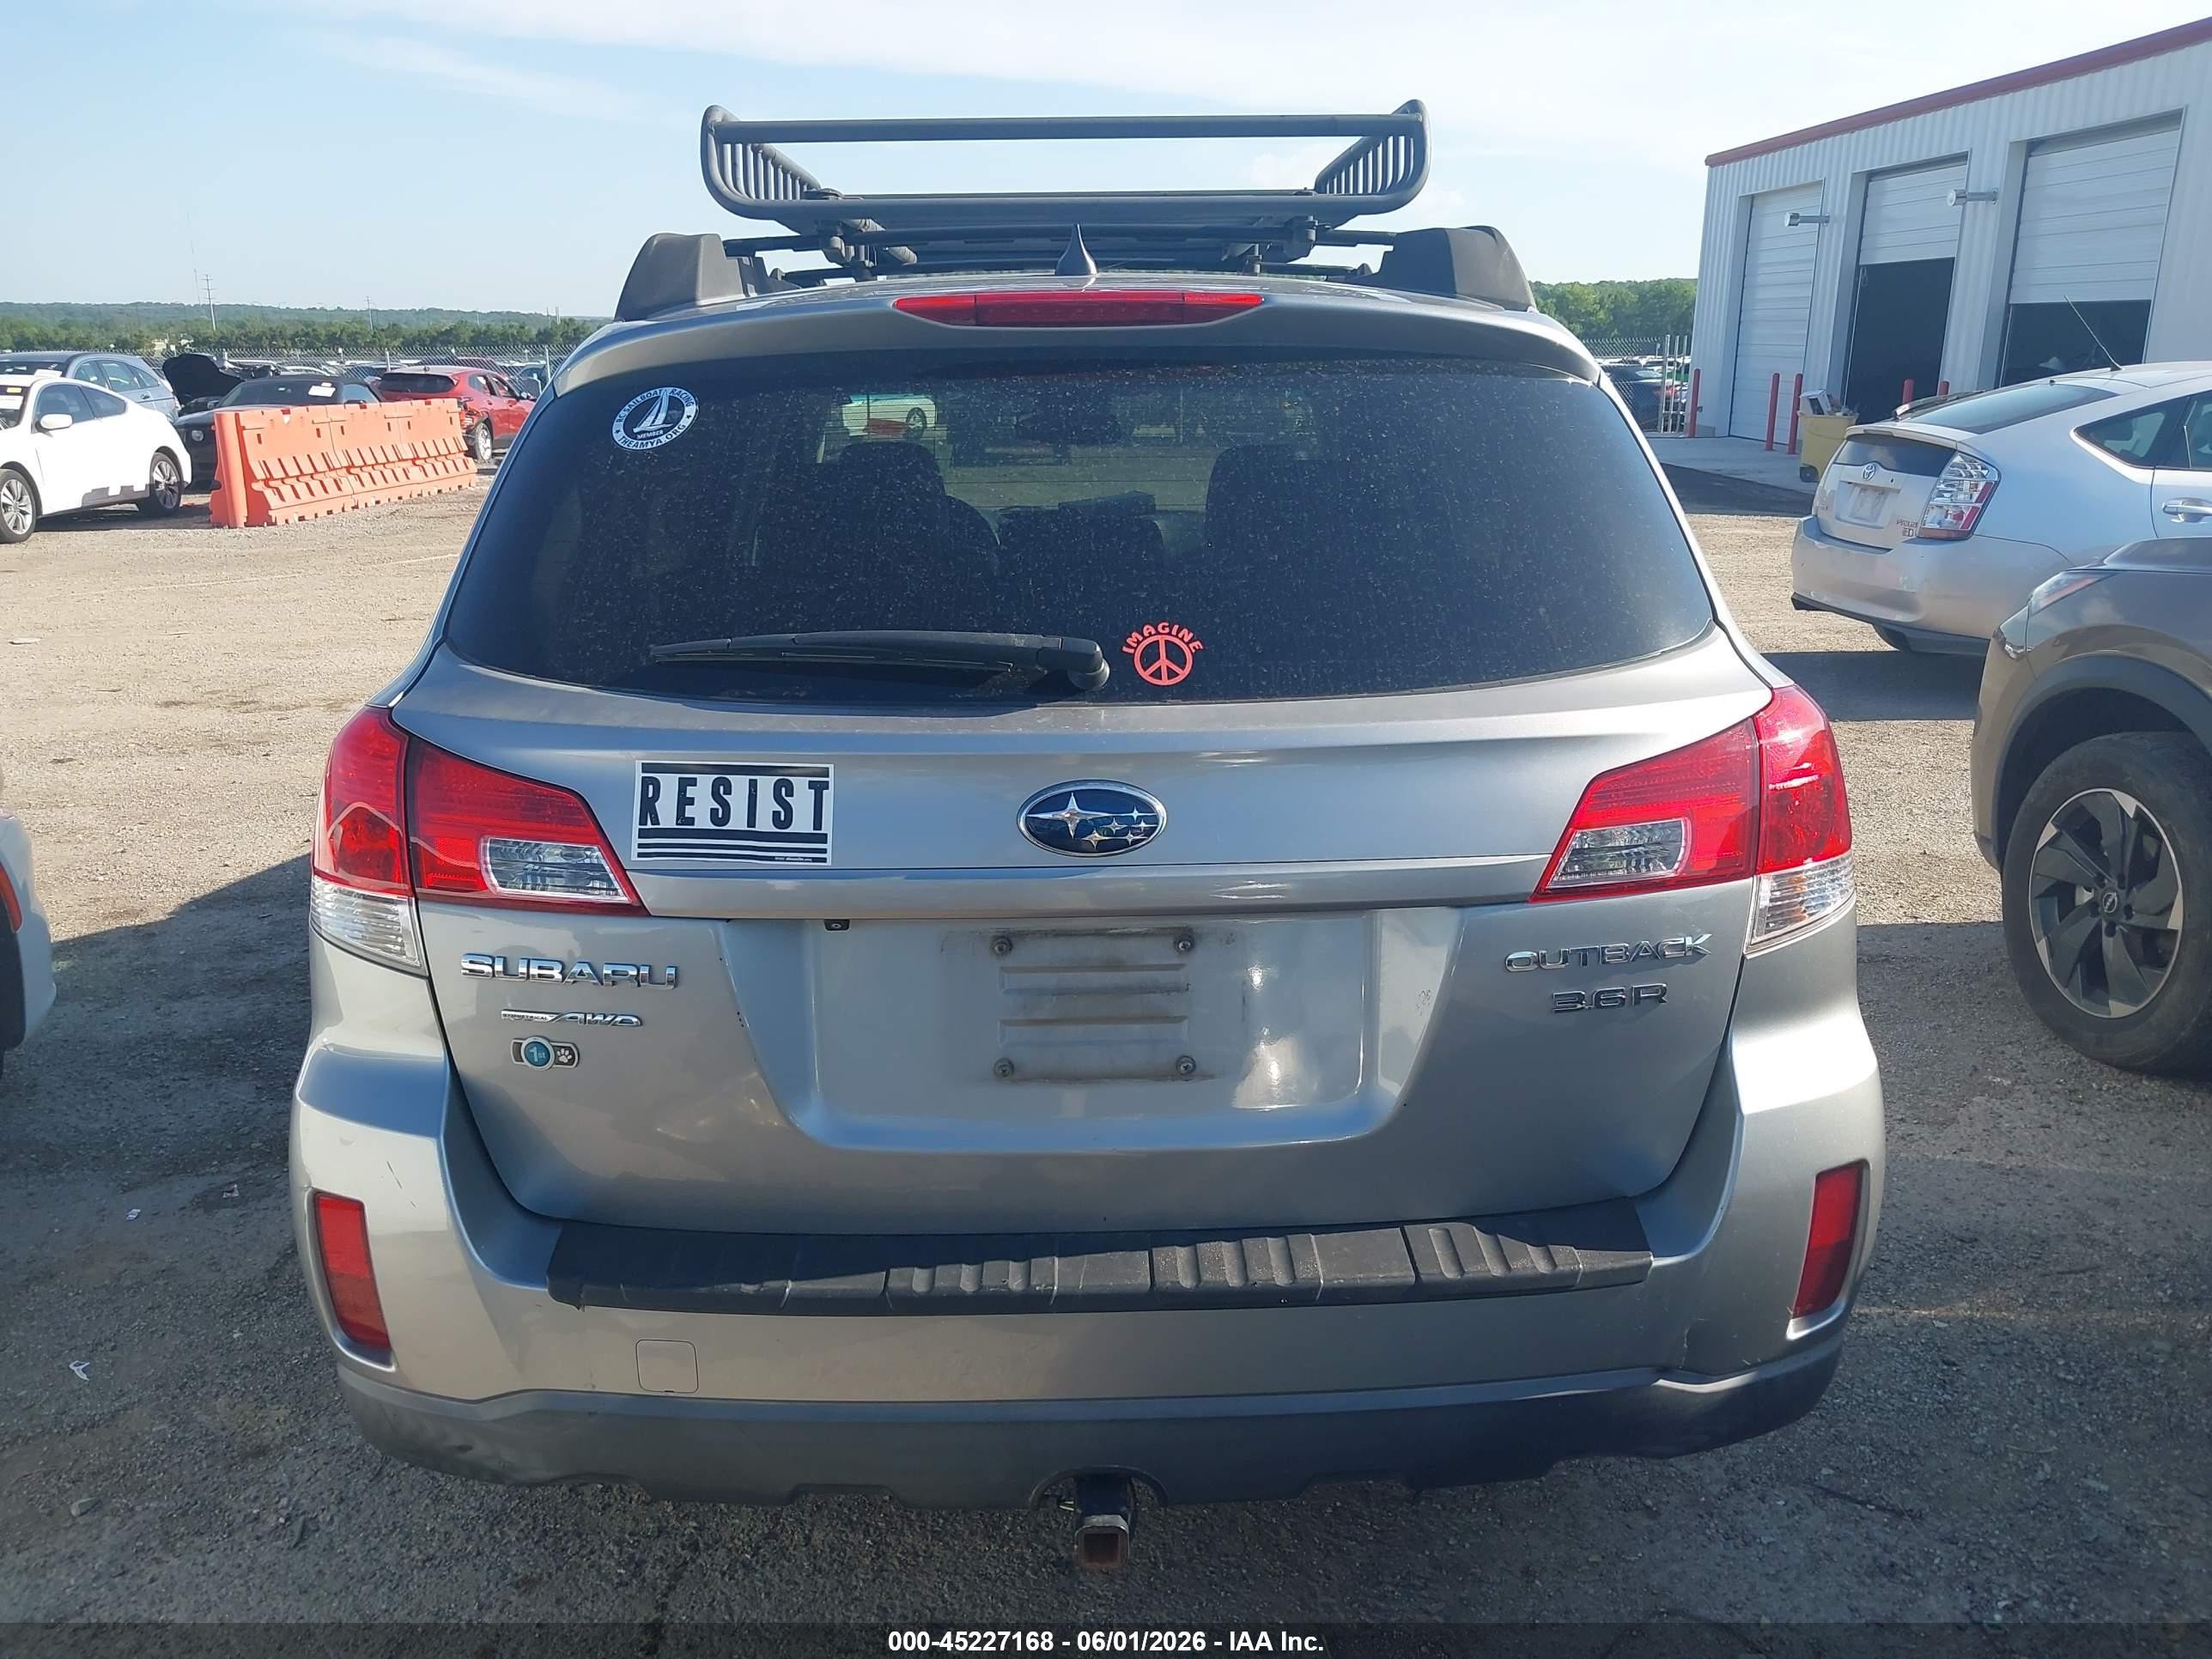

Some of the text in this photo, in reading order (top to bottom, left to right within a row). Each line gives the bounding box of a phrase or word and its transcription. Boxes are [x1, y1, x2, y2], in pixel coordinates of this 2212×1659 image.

[624, 389, 663, 413] SAILBOAT
[670, 389, 695, 407] RACING
[618, 423, 687, 448] THEAMYA.ORG
[636, 428, 665, 440] MEMBER
[1122, 622, 1203, 653] IMAGINE
[639, 775, 830, 831] RESIST
[1504, 933, 1713, 973] OUTBACK
[460, 953, 678, 990] SUBARU
[1551, 982, 1668, 1014] 3.6R
[553, 1012, 643, 1027] AWD
